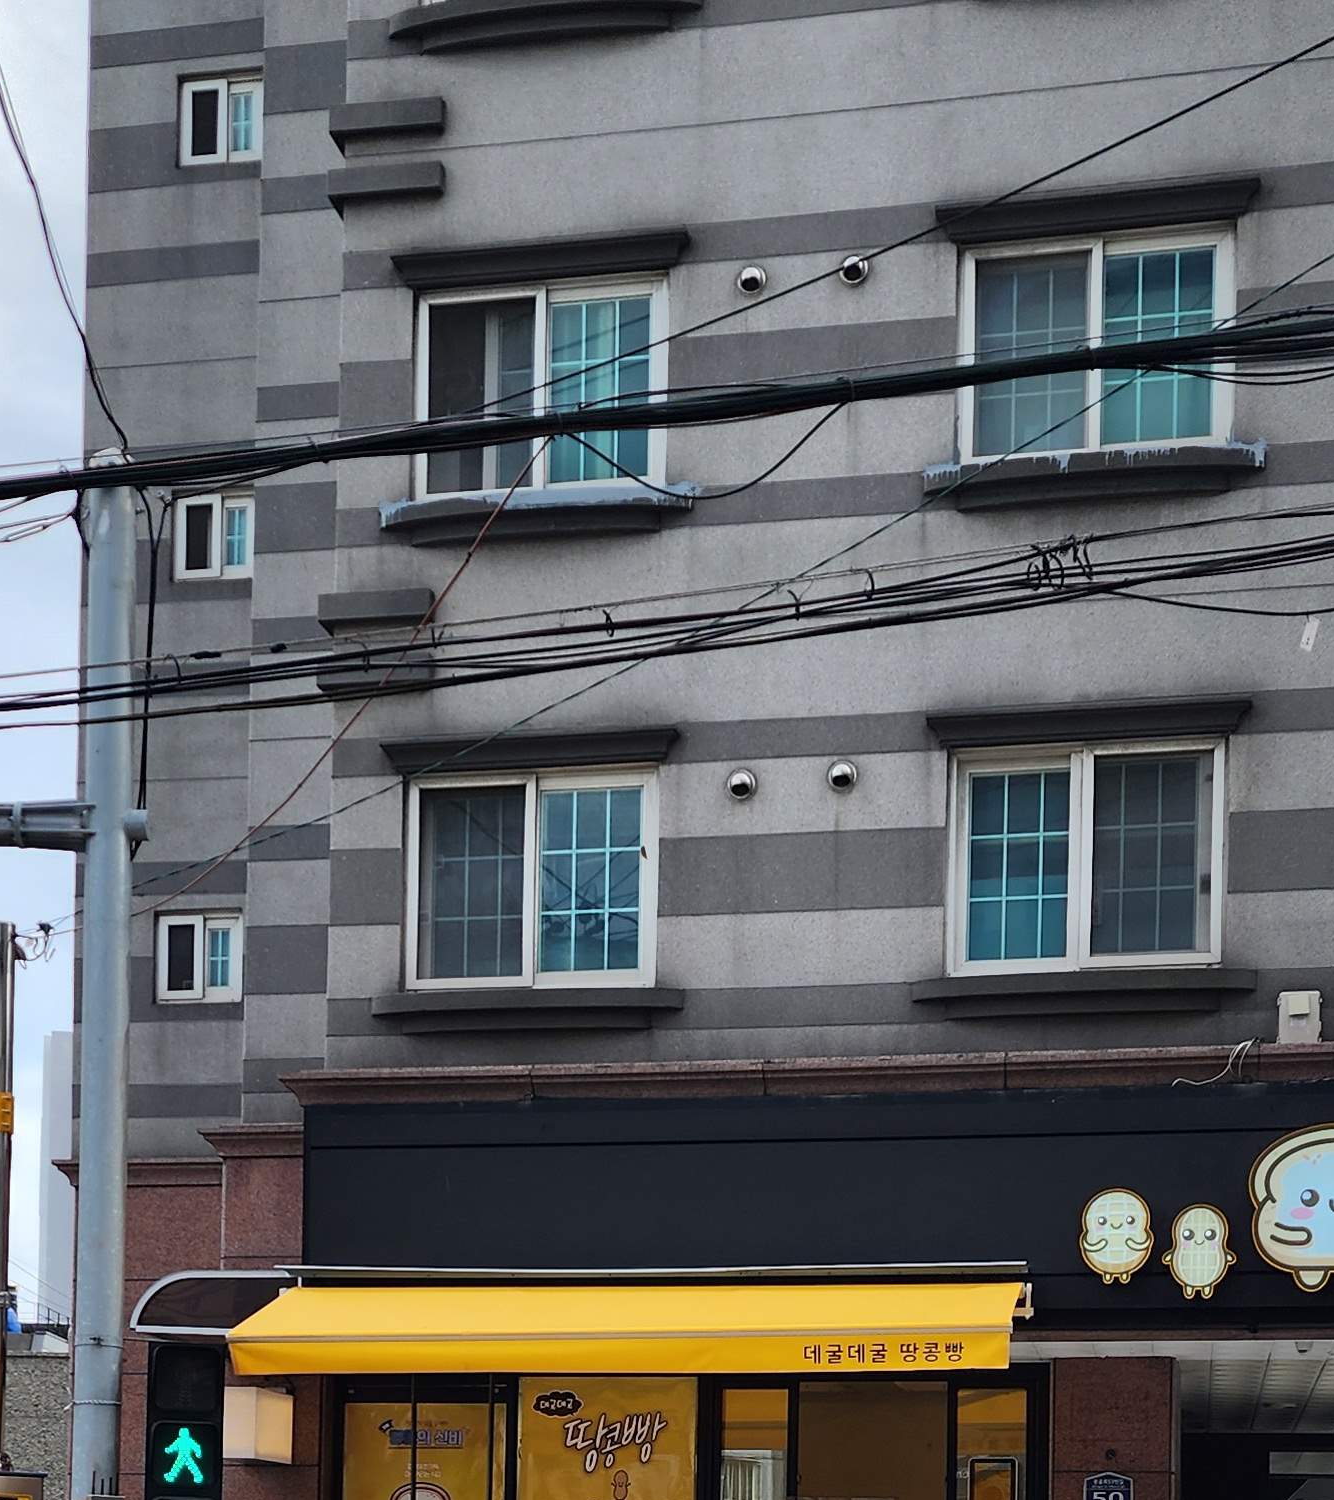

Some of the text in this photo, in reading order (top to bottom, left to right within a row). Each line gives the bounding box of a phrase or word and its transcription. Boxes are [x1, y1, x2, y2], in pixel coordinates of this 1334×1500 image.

[803, 1341, 965, 1364] 데굴데굴 땅콩빵
[564, 1412, 667, 1473] 땅콩빵
